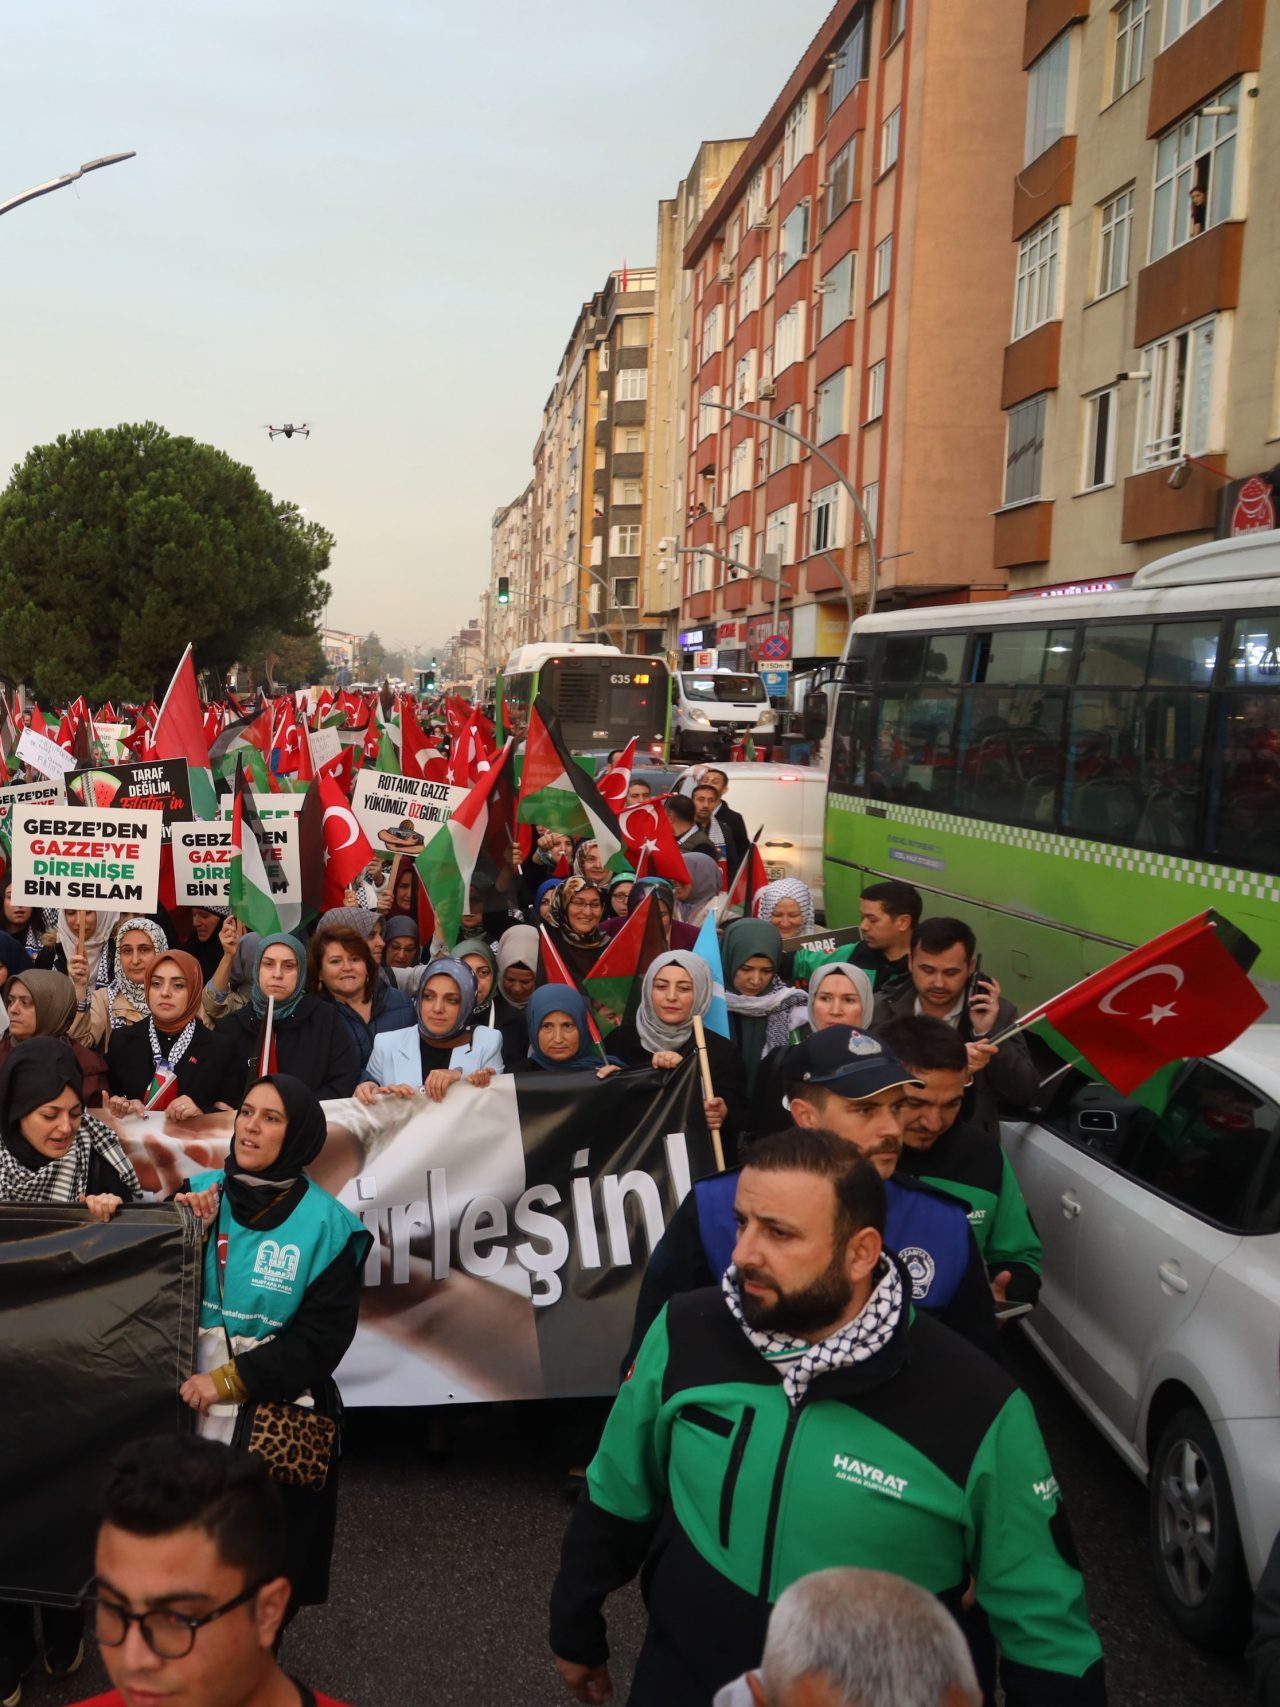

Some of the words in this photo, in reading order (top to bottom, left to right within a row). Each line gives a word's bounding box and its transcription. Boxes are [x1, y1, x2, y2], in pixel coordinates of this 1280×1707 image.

[700, 654, 709, 664] E
[610, 674, 631, 684] 635
[131, 767, 164, 782] TARAF
[129, 779, 171, 797] DEĞİLİM
[377, 774, 420, 796] ROTAMIZ
[420, 782, 451, 801] GAZZE
[364, 792, 408, 816] YÜKÜMÜZ
[408, 799, 453, 824] ÖZGÜRLÜ
[23, 819, 148, 839] GEBZE'DEN
[30, 839, 140, 859] GAZZE'YE
[33, 857, 135, 881] DİRENİŞE
[24, 877, 61, 896] BİN
[67, 882, 143, 900] SELAM
[186, 881, 218, 896] BİN
[800, 938, 836, 953] TARAF
[357, 1132, 692, 1307] irleşin!
[833, 1453, 908, 1493] HAYRAT
